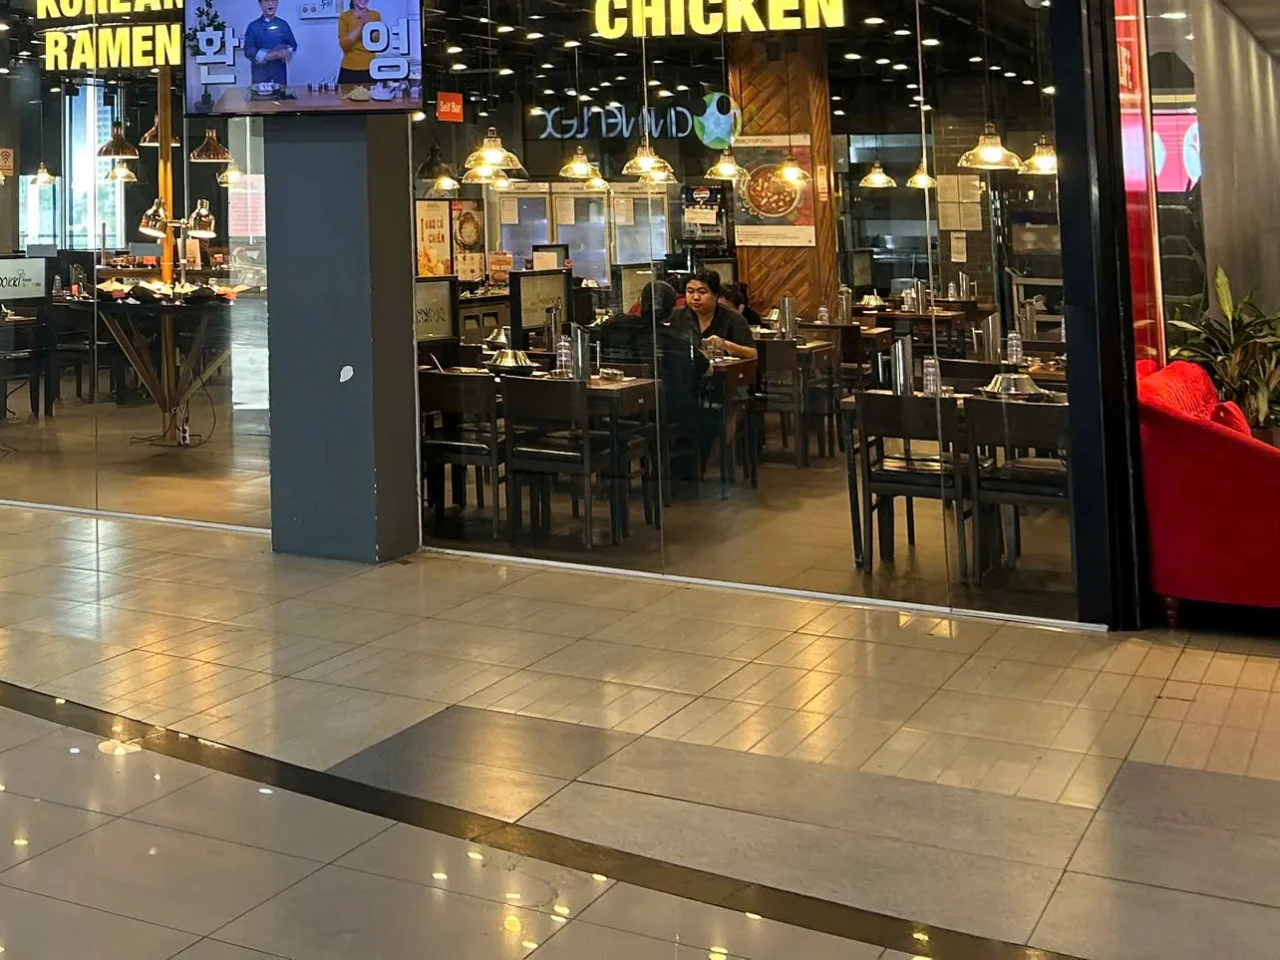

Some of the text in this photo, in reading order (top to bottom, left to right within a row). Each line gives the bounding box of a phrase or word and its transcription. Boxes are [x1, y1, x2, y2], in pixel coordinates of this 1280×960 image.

[45, 24, 180, 72] RAMEN
[196, 18, 410, 85] 환 영
